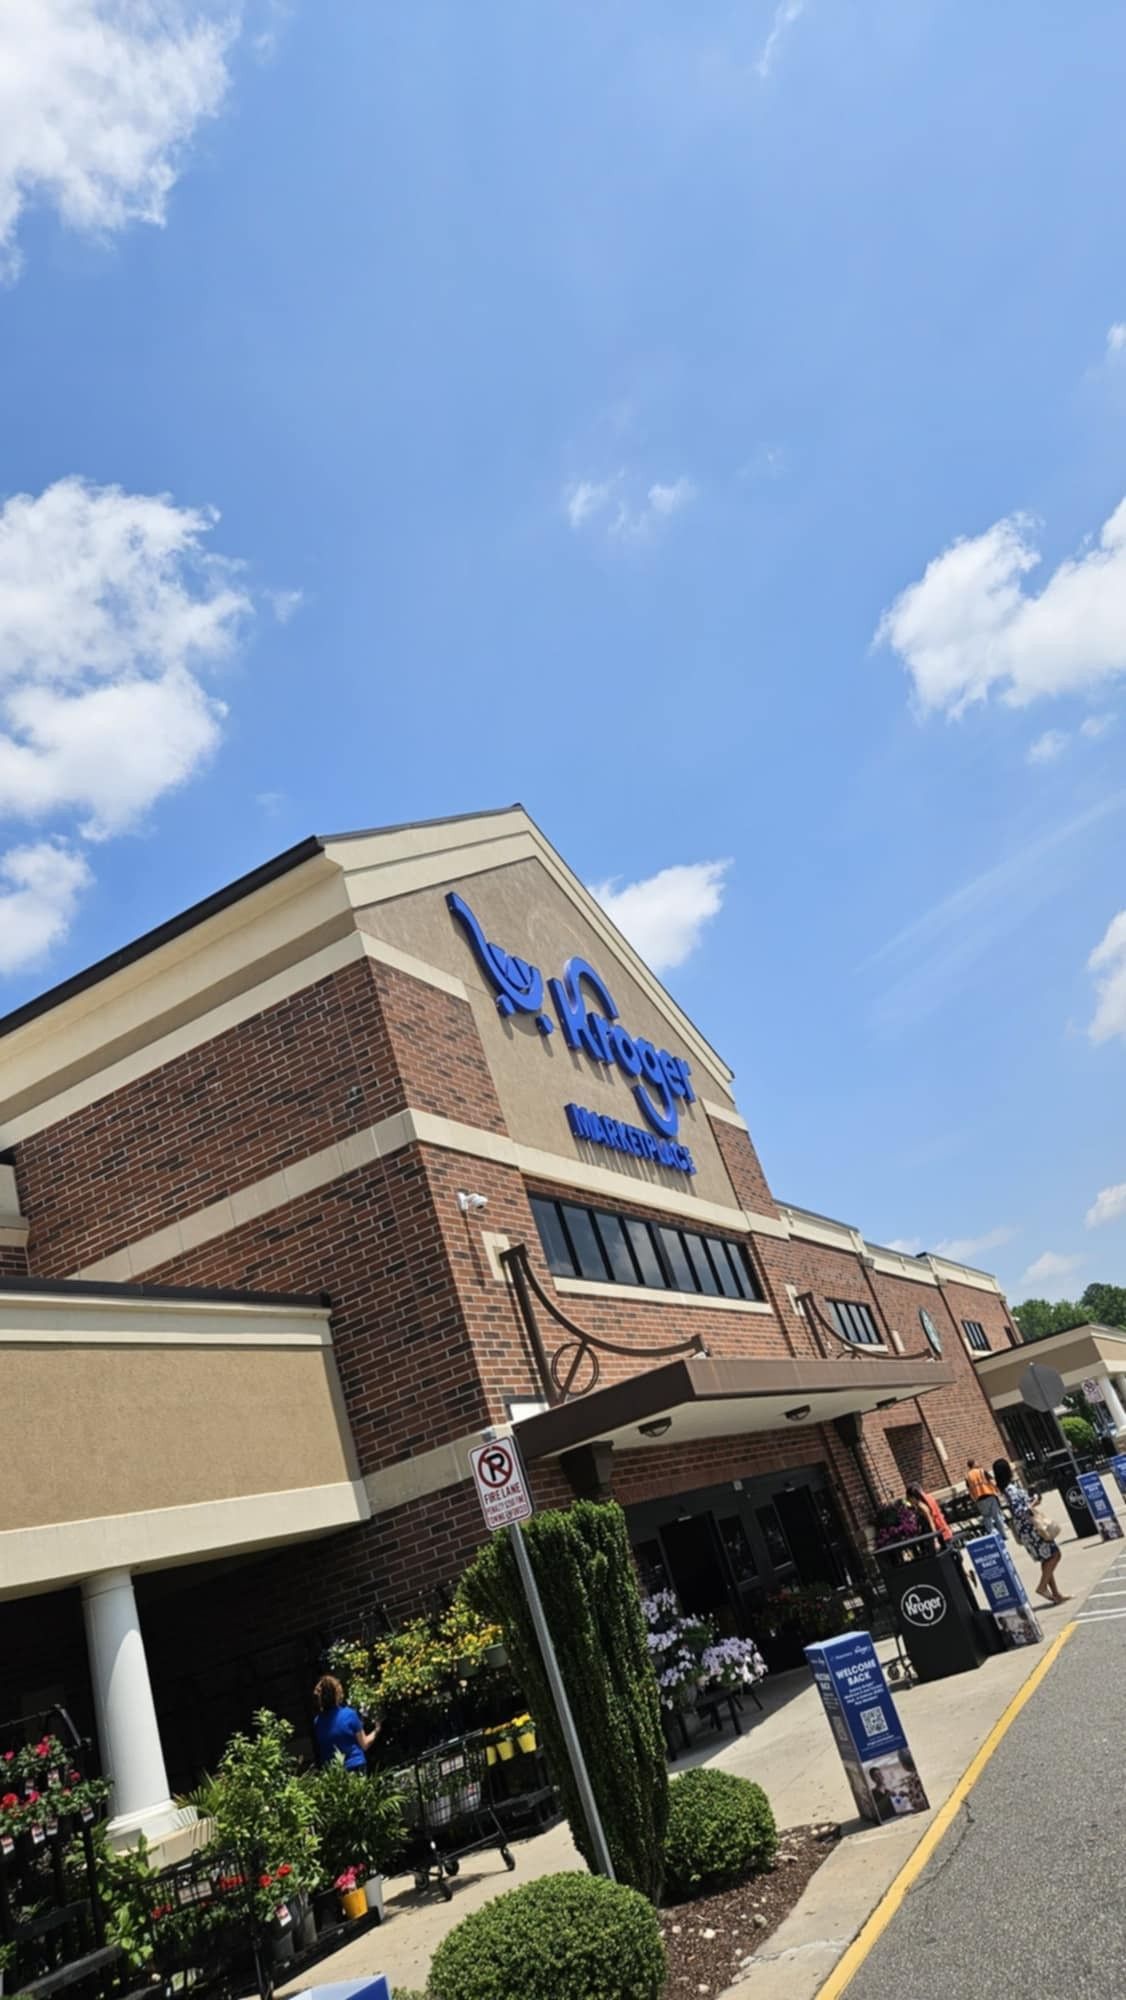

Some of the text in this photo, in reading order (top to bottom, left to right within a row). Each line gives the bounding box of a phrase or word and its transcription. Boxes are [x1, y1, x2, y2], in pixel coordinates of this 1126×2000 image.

[547, 955, 696, 1138] Kroger
[564, 1102, 698, 1176] MARKETPLACE
[484, 1490, 501, 1505] FIRE
[501, 1482, 521, 1499] LANE
[904, 1593, 942, 1620] Kroger
[835, 1658, 877, 1680] WELCOME
[847, 1671, 872, 1686] BACK
